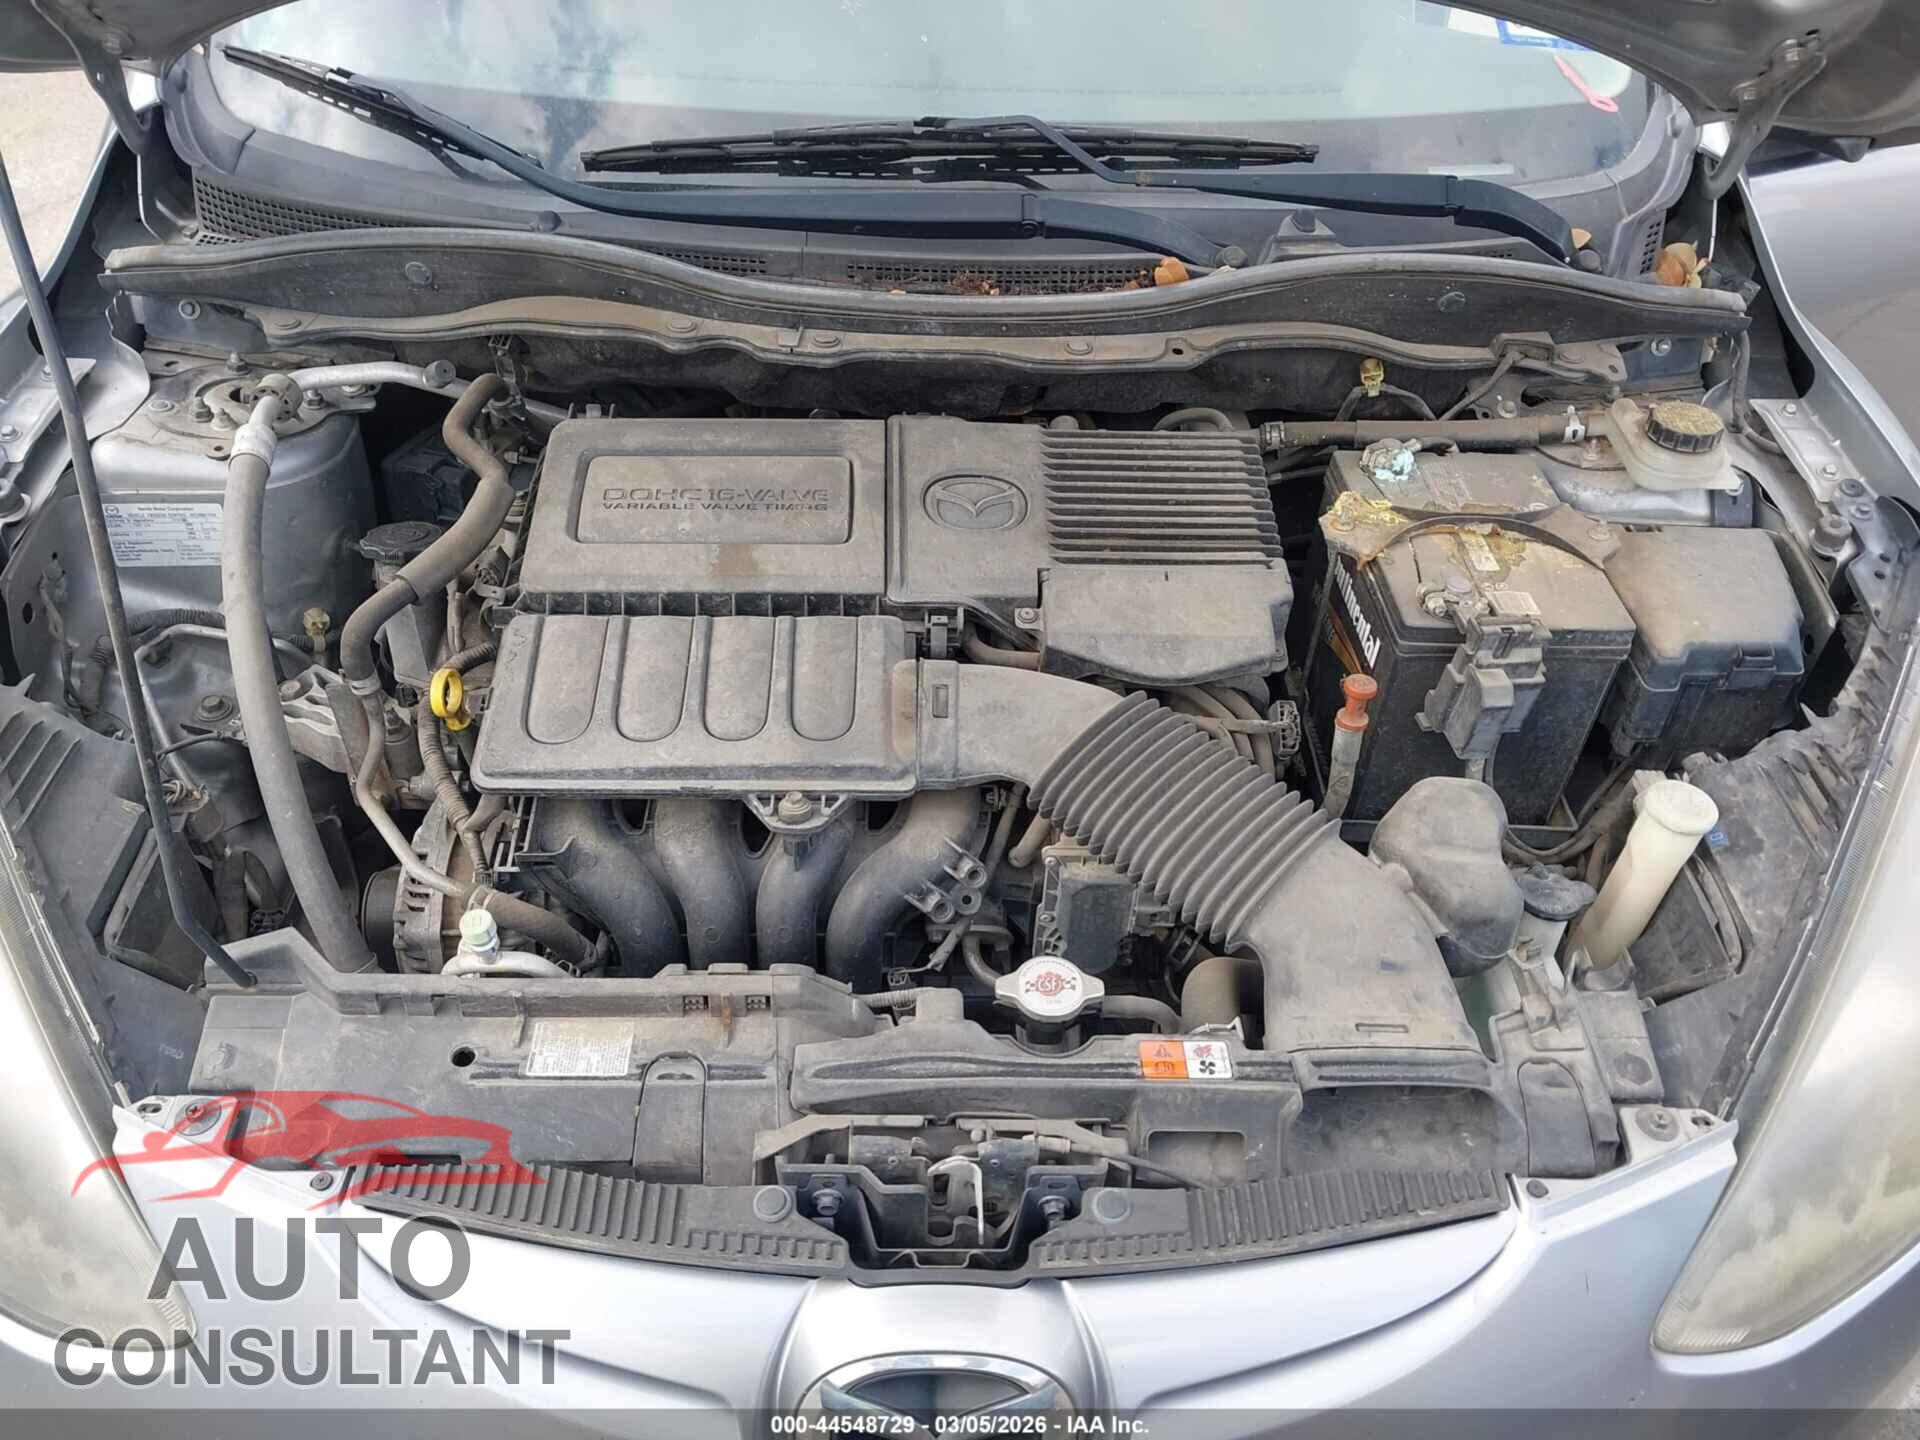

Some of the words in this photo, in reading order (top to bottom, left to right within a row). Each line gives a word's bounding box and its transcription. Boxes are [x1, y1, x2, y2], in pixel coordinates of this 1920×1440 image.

[603, 488, 702, 501] DOHC
[708, 488, 828, 501] 16-VALVE
[602, 502, 696, 511] VARIABLE
[700, 502, 759, 511] VALVE
[1335, 553, 1380, 670] ntinental
